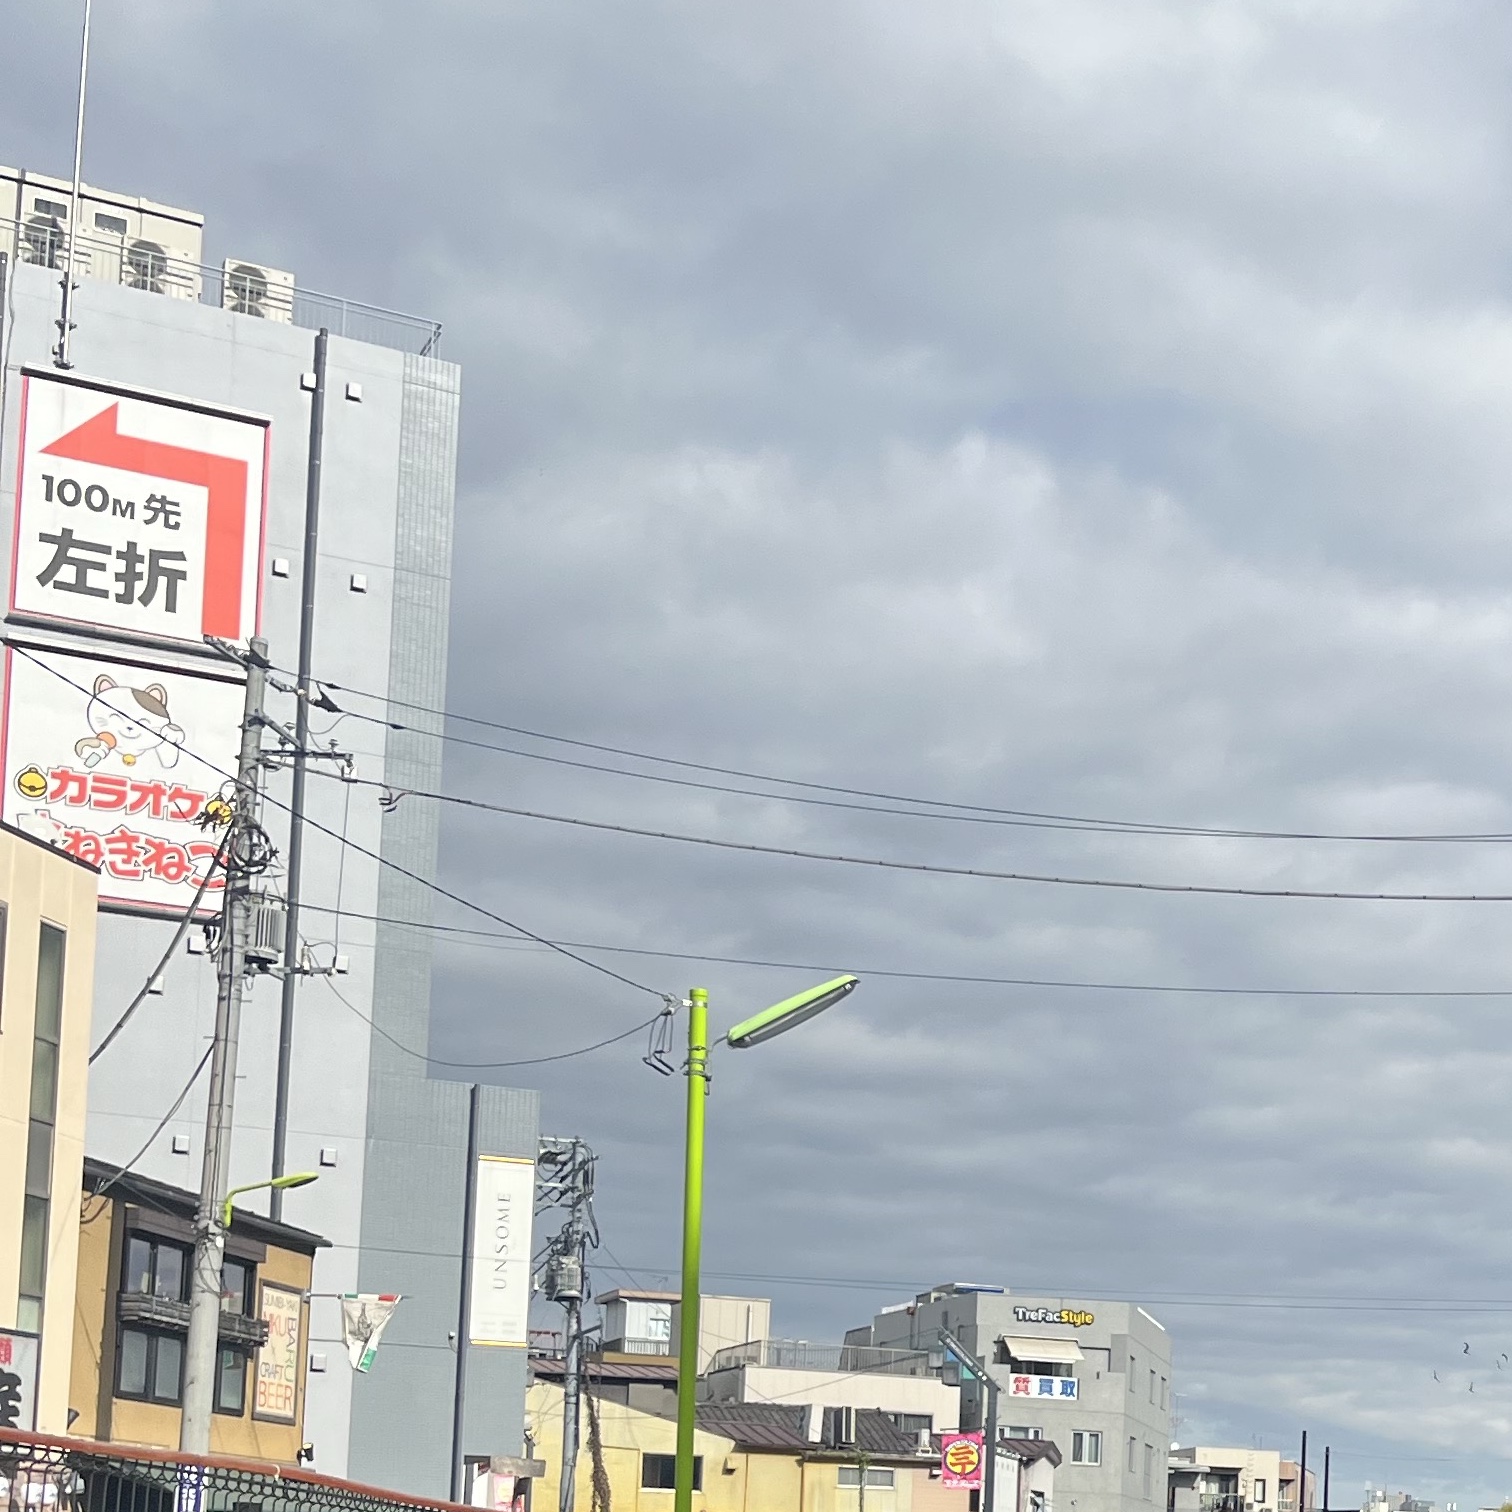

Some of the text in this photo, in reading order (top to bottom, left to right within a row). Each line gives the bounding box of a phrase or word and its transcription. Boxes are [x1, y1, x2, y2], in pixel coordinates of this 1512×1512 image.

[36, 527, 187, 613] 左折
[49, 768, 206, 822] カラオケ
[28, 811, 228, 888] ねきねこ
[493, 1192, 511, 1290] UNSOME
[1013, 1306, 1095, 1328] TreFacStyle
[258, 1381, 293, 1412] BEER
[260, 1361, 284, 1380] CRAFT
